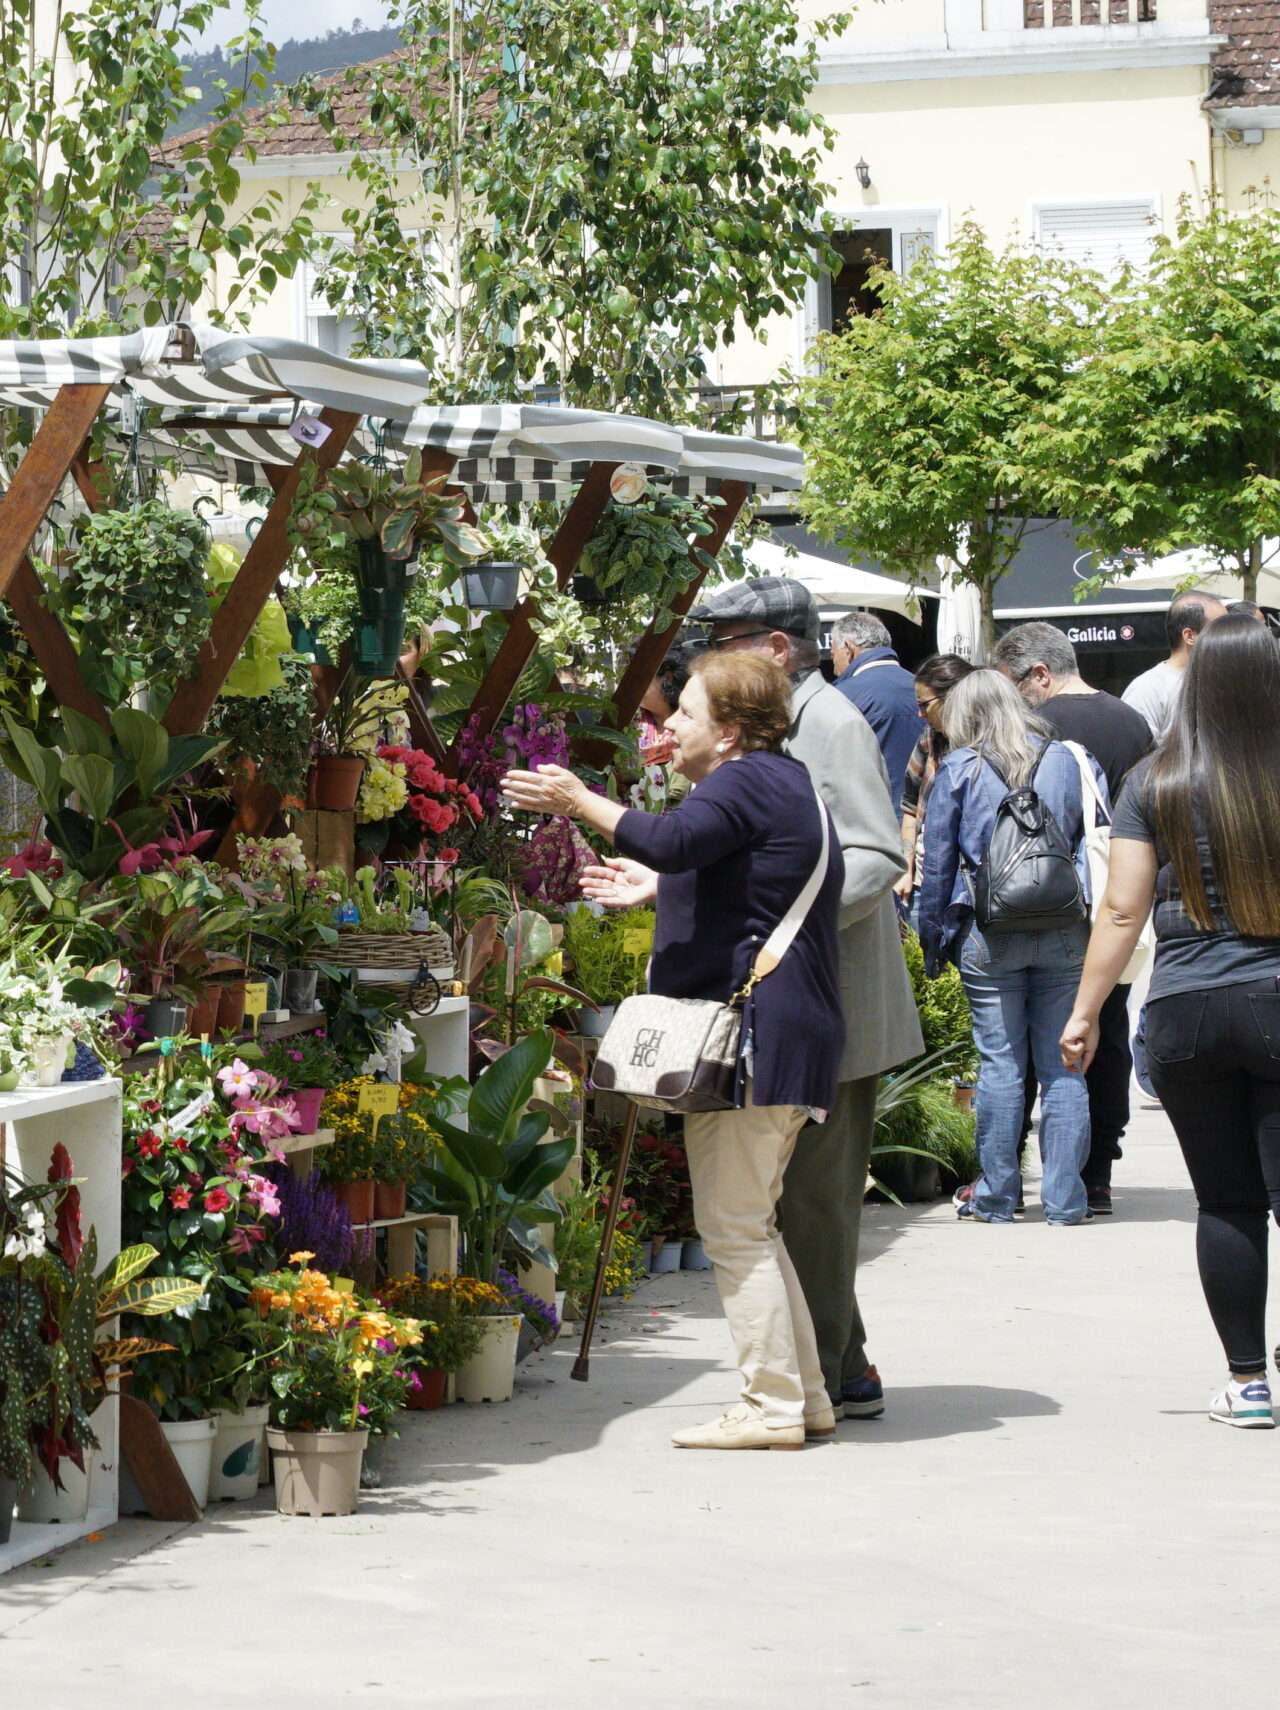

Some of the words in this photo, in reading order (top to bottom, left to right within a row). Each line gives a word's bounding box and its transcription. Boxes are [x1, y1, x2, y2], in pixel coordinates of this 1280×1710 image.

[1067, 626, 1117, 643] Galicia
[636, 1028, 667, 1048] CH
[630, 1045, 658, 1067] HC
